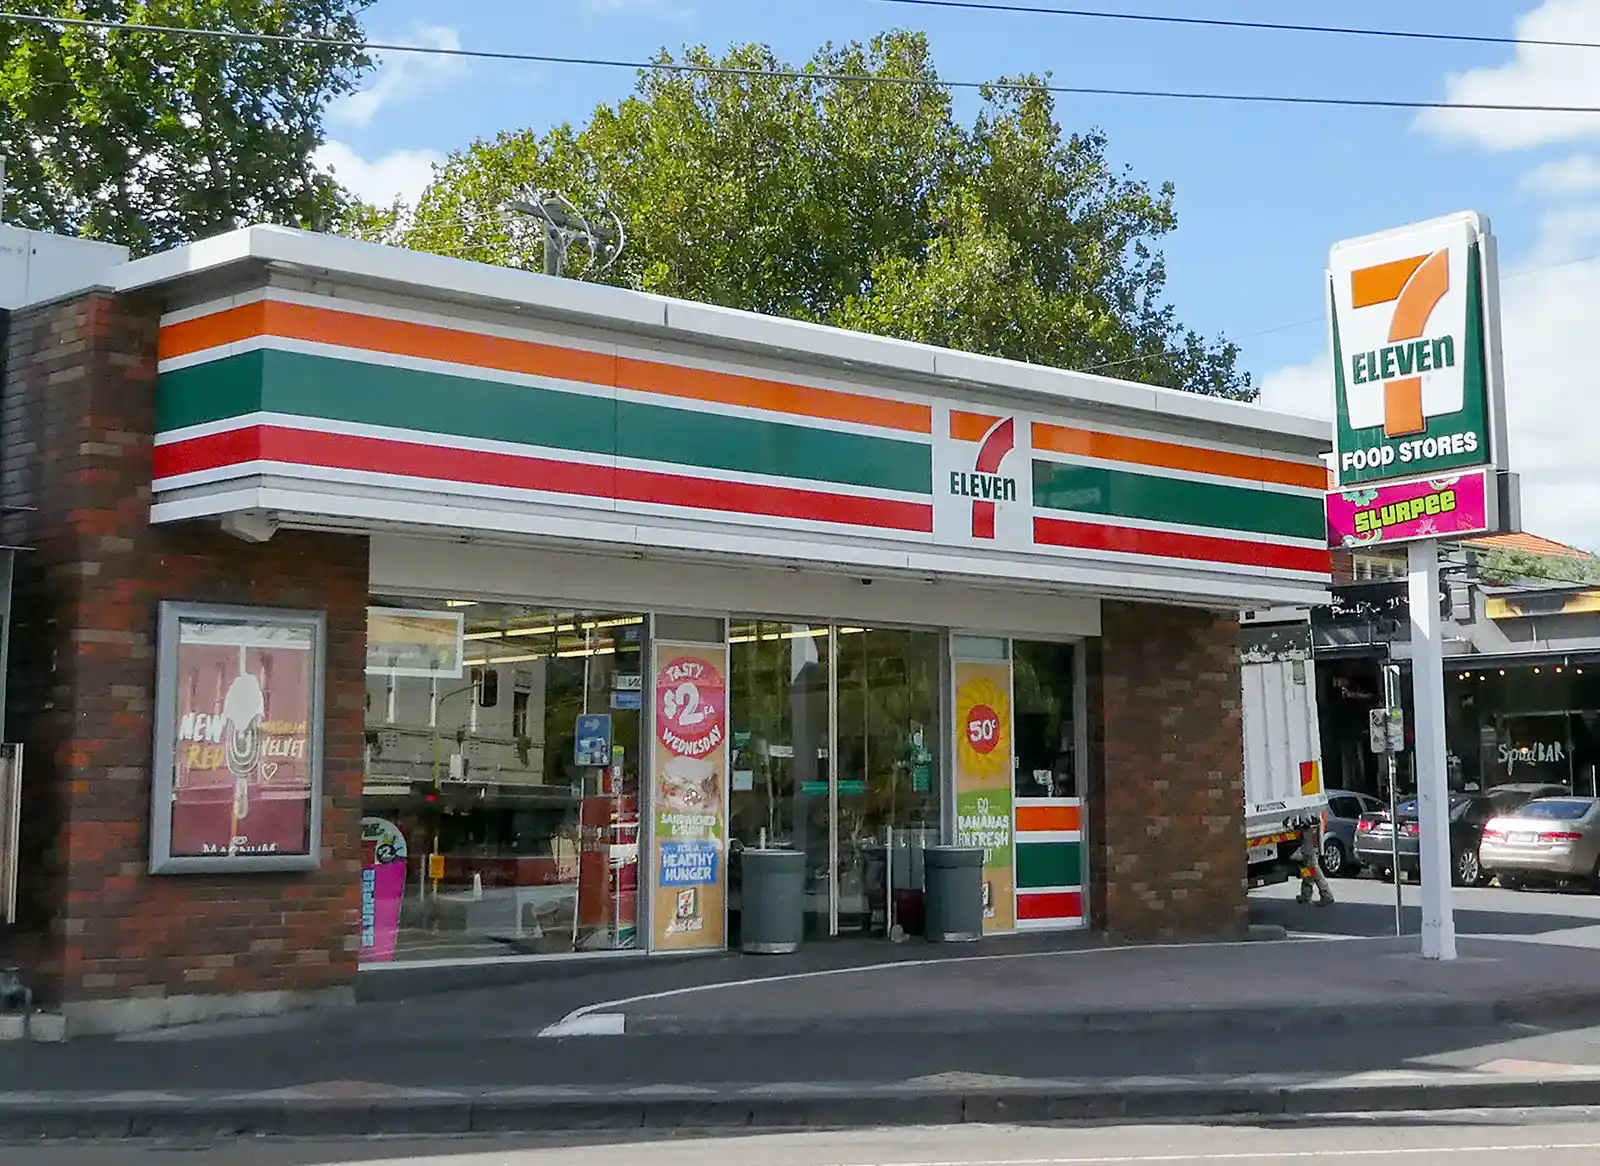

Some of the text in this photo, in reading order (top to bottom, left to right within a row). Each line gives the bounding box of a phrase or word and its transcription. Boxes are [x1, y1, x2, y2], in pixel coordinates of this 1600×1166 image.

[1341, 431, 1478, 472] FOOD STORES
[666, 662, 704, 681] TASTY
[663, 682, 704, 726] $2
[179, 712, 226, 743] NEW
[261, 735, 305, 758] VELVET
[662, 724, 722, 756] WEDNESDAY
[958, 815, 1009, 830] BANANAS
[972, 830, 1009, 848] FRESH
[663, 852, 714, 868] HEALTHY
[665, 866, 712, 882] HUNGER
